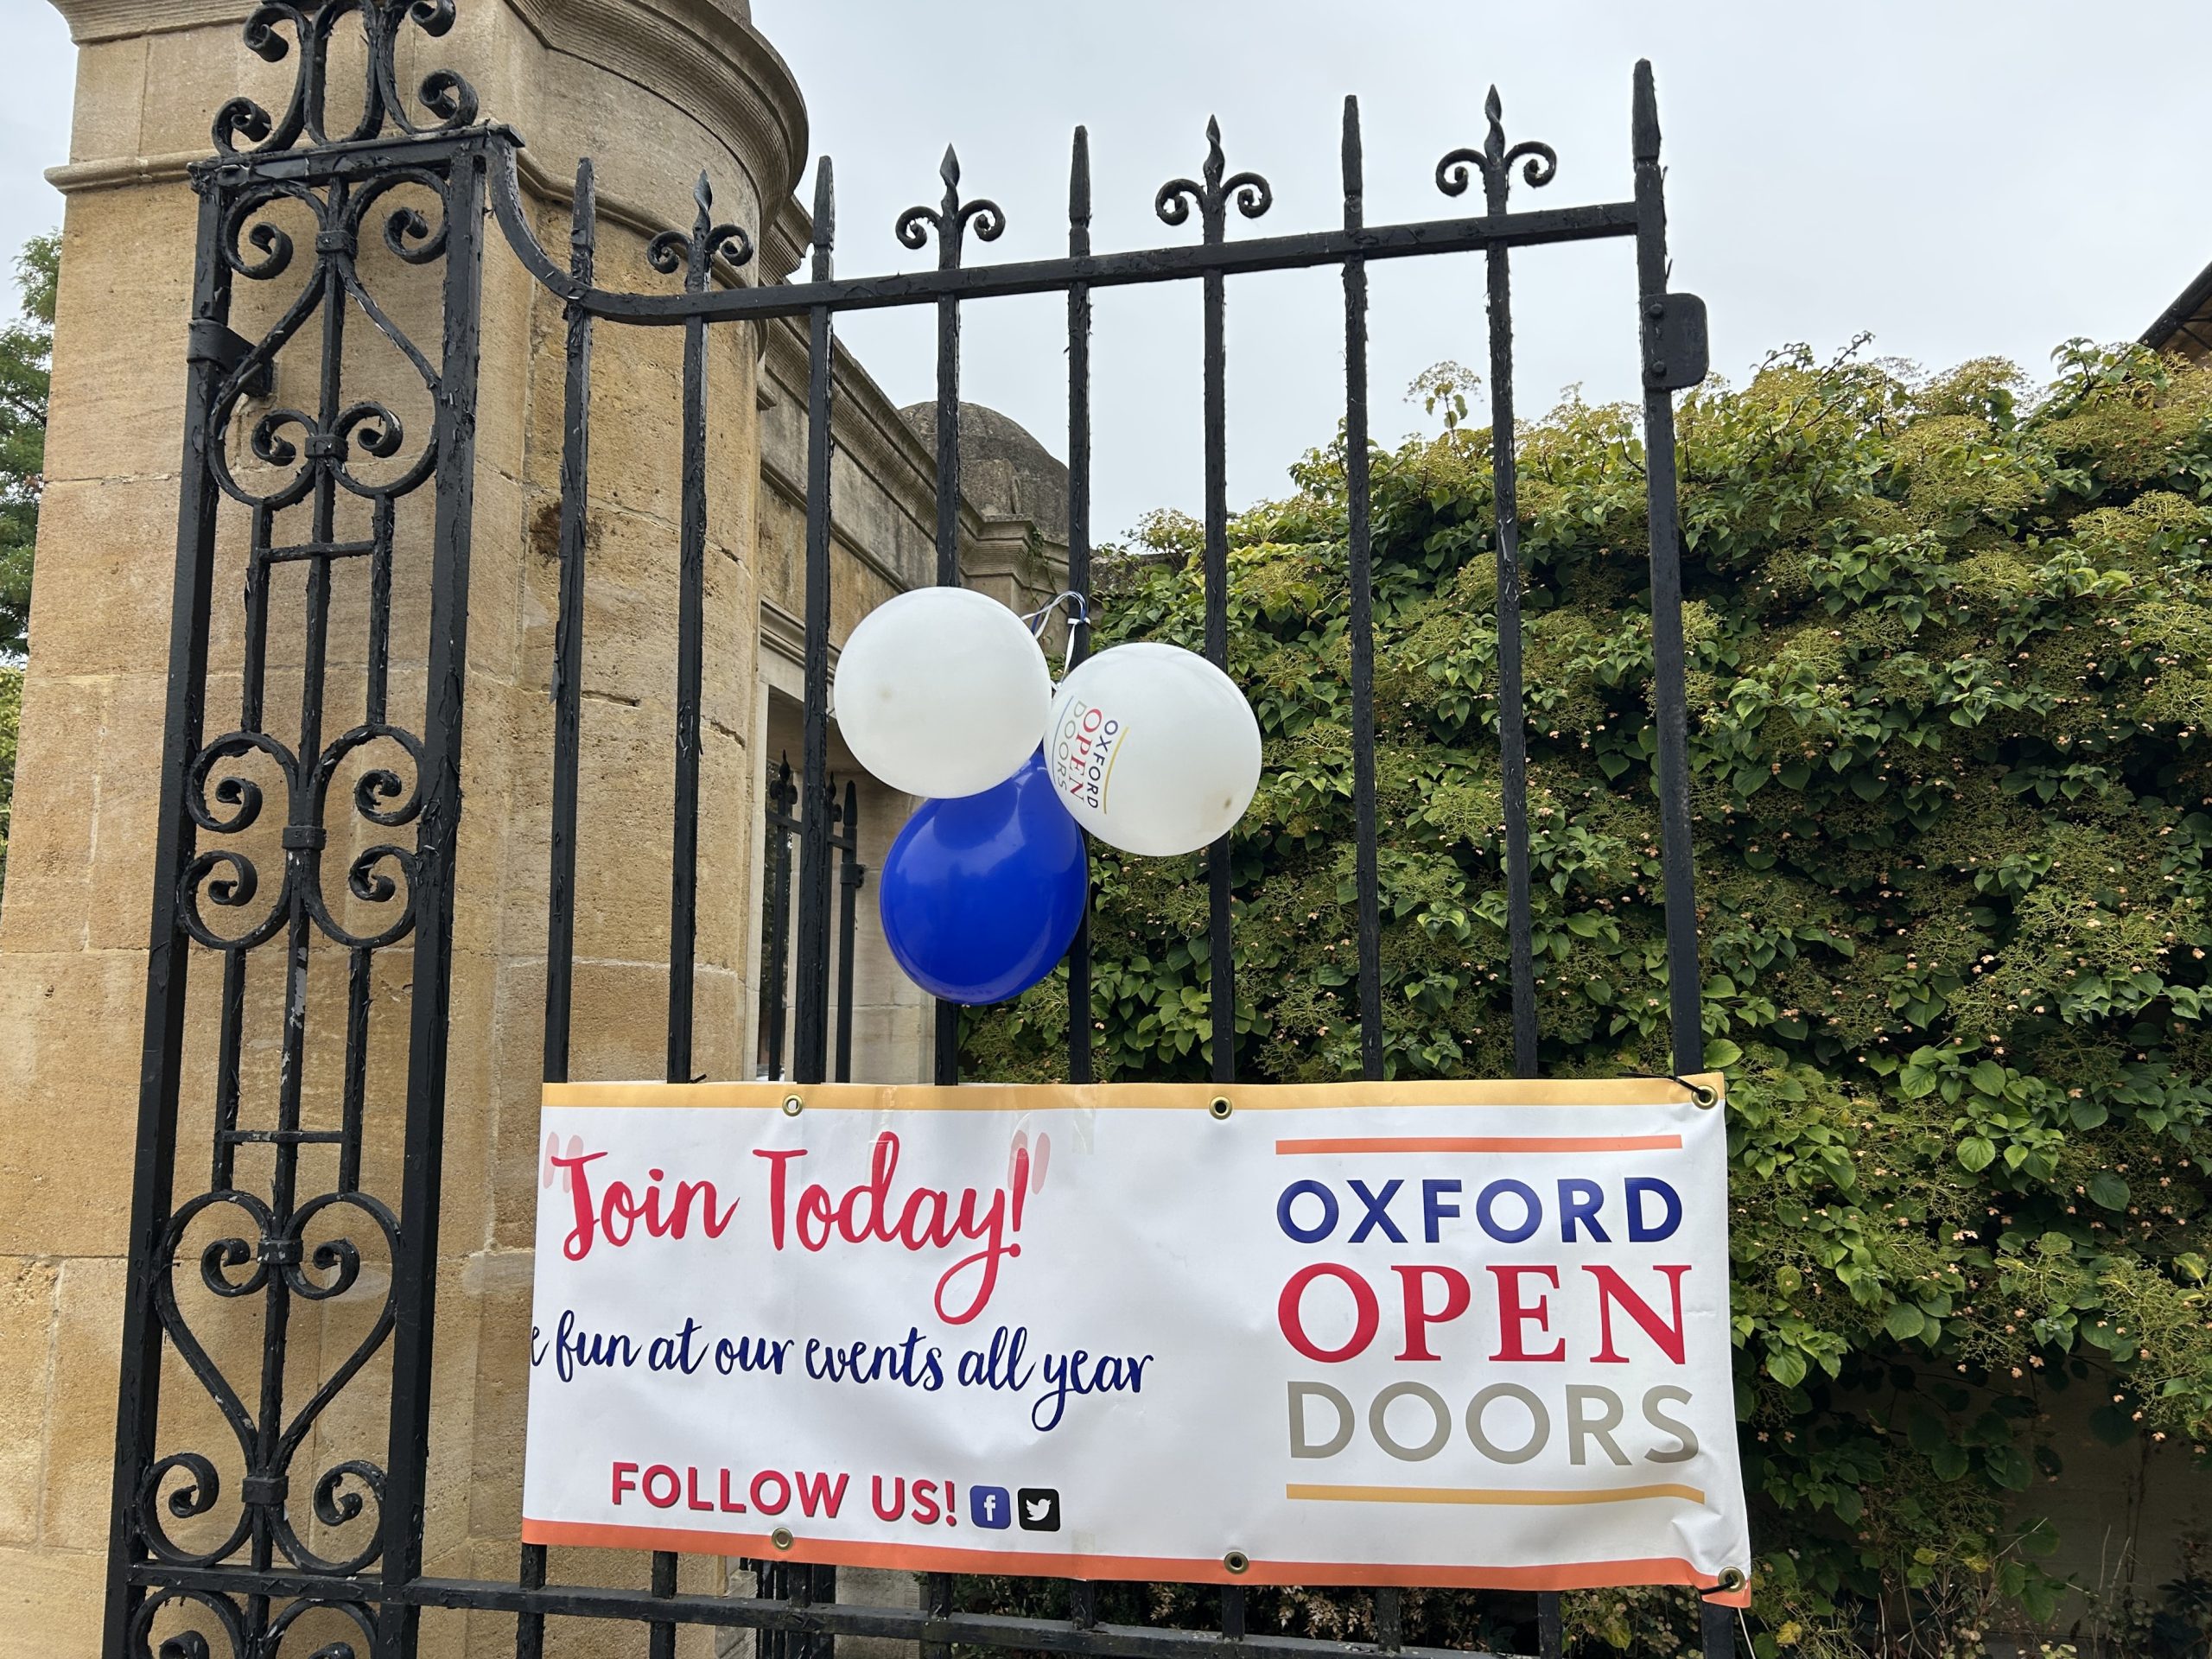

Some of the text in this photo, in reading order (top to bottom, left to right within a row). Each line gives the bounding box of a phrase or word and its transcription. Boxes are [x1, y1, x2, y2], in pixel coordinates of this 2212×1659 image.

[1057, 700, 1088, 791] DOORS
[1069, 708, 1103, 803] OPEN
[1086, 719, 1119, 810] OXFORD
[1276, 1176, 1683, 1244] OXFORD
[1278, 1262, 1692, 1365] OPEN
[555, 1309, 641, 1382] fun
[648, 1317, 710, 1376] at
[715, 1338, 795, 1376] our
[805, 1327, 944, 1391] events
[957, 1326, 1037, 1393] all
[1032, 1355, 1154, 1432] year
[1287, 1381, 1699, 1466] DOORS
[612, 1462, 957, 1527] FOLLOW US!
